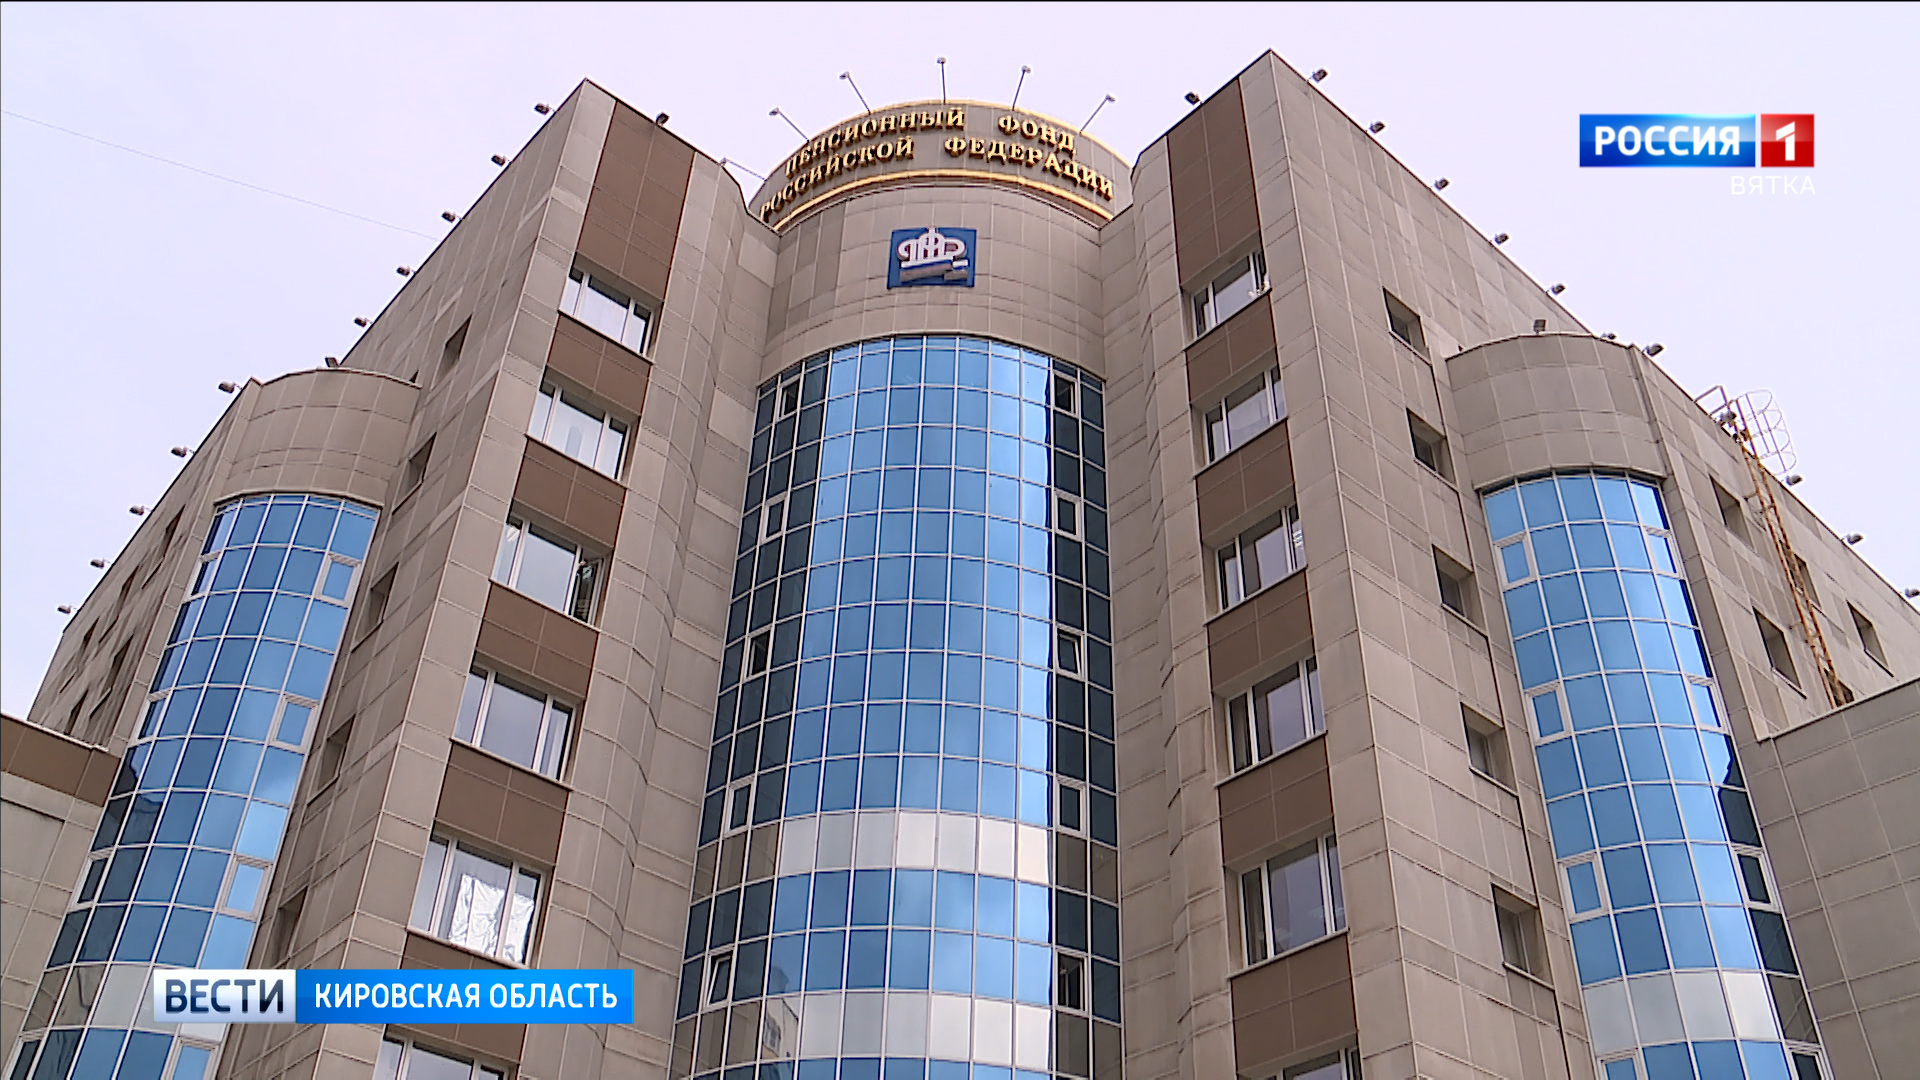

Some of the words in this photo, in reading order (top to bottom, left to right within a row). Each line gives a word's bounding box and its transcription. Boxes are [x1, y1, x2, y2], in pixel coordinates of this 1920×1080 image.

[760, 136, 915, 222] РОССИЙСКОЙ
[944, 136, 1114, 200] ФЕДЕРАЦИИ
[785, 107, 965, 178] ПЕНСИОННЫЙ
[998, 115, 1076, 156] ФОНД
